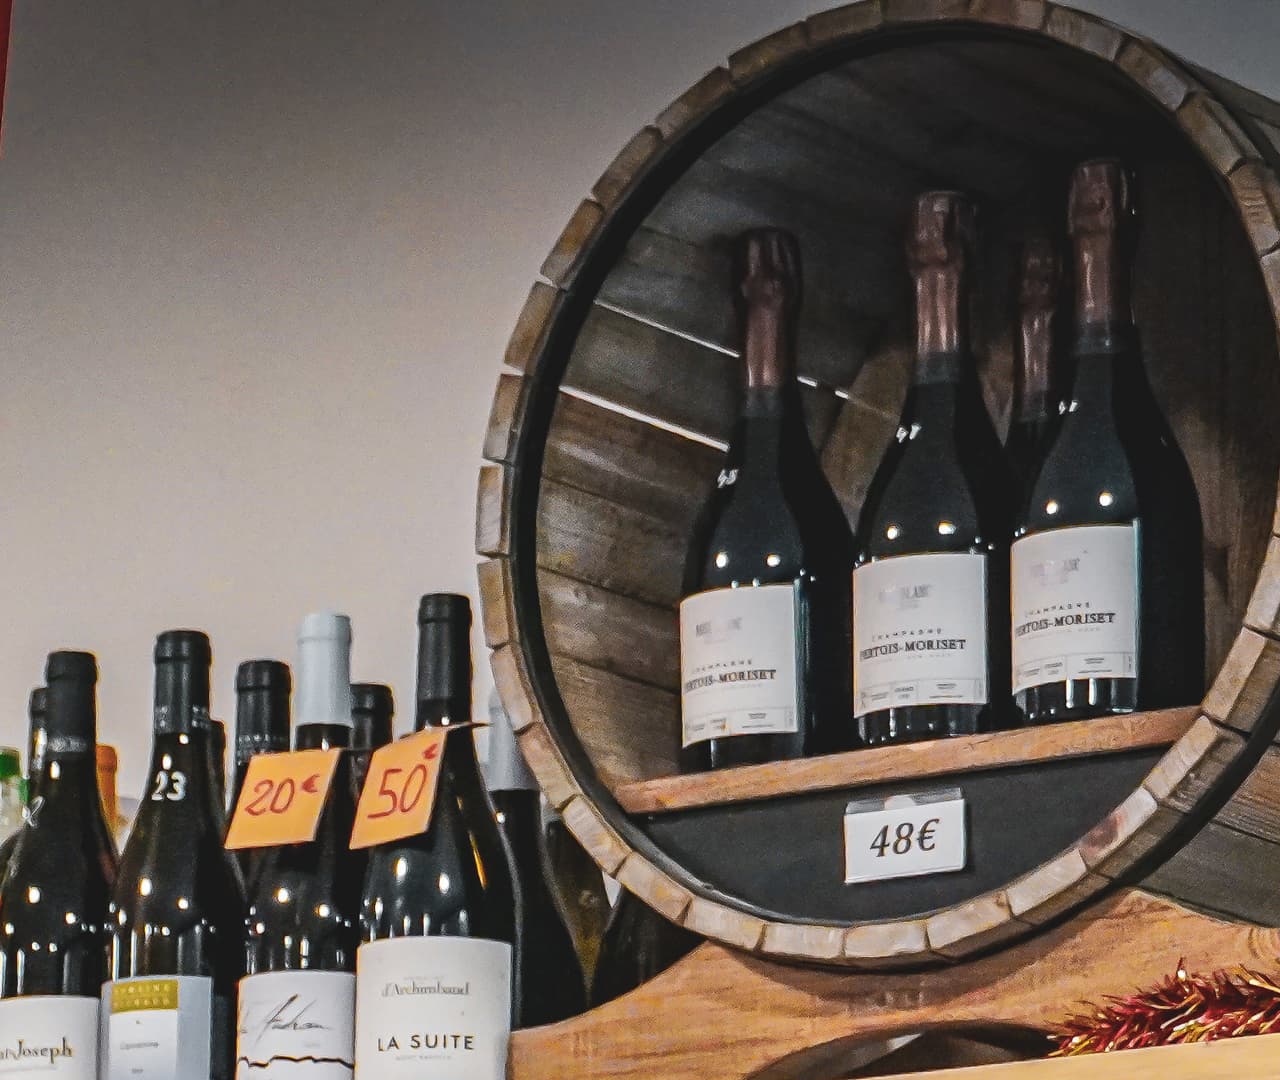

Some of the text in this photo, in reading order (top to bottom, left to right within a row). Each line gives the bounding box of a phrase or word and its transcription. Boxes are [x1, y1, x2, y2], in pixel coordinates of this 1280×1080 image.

[870, 818, 940, 858] 48€
[16, 1036, 74, 1065] Joseph
[377, 1034, 475, 1052] LA SUITE
